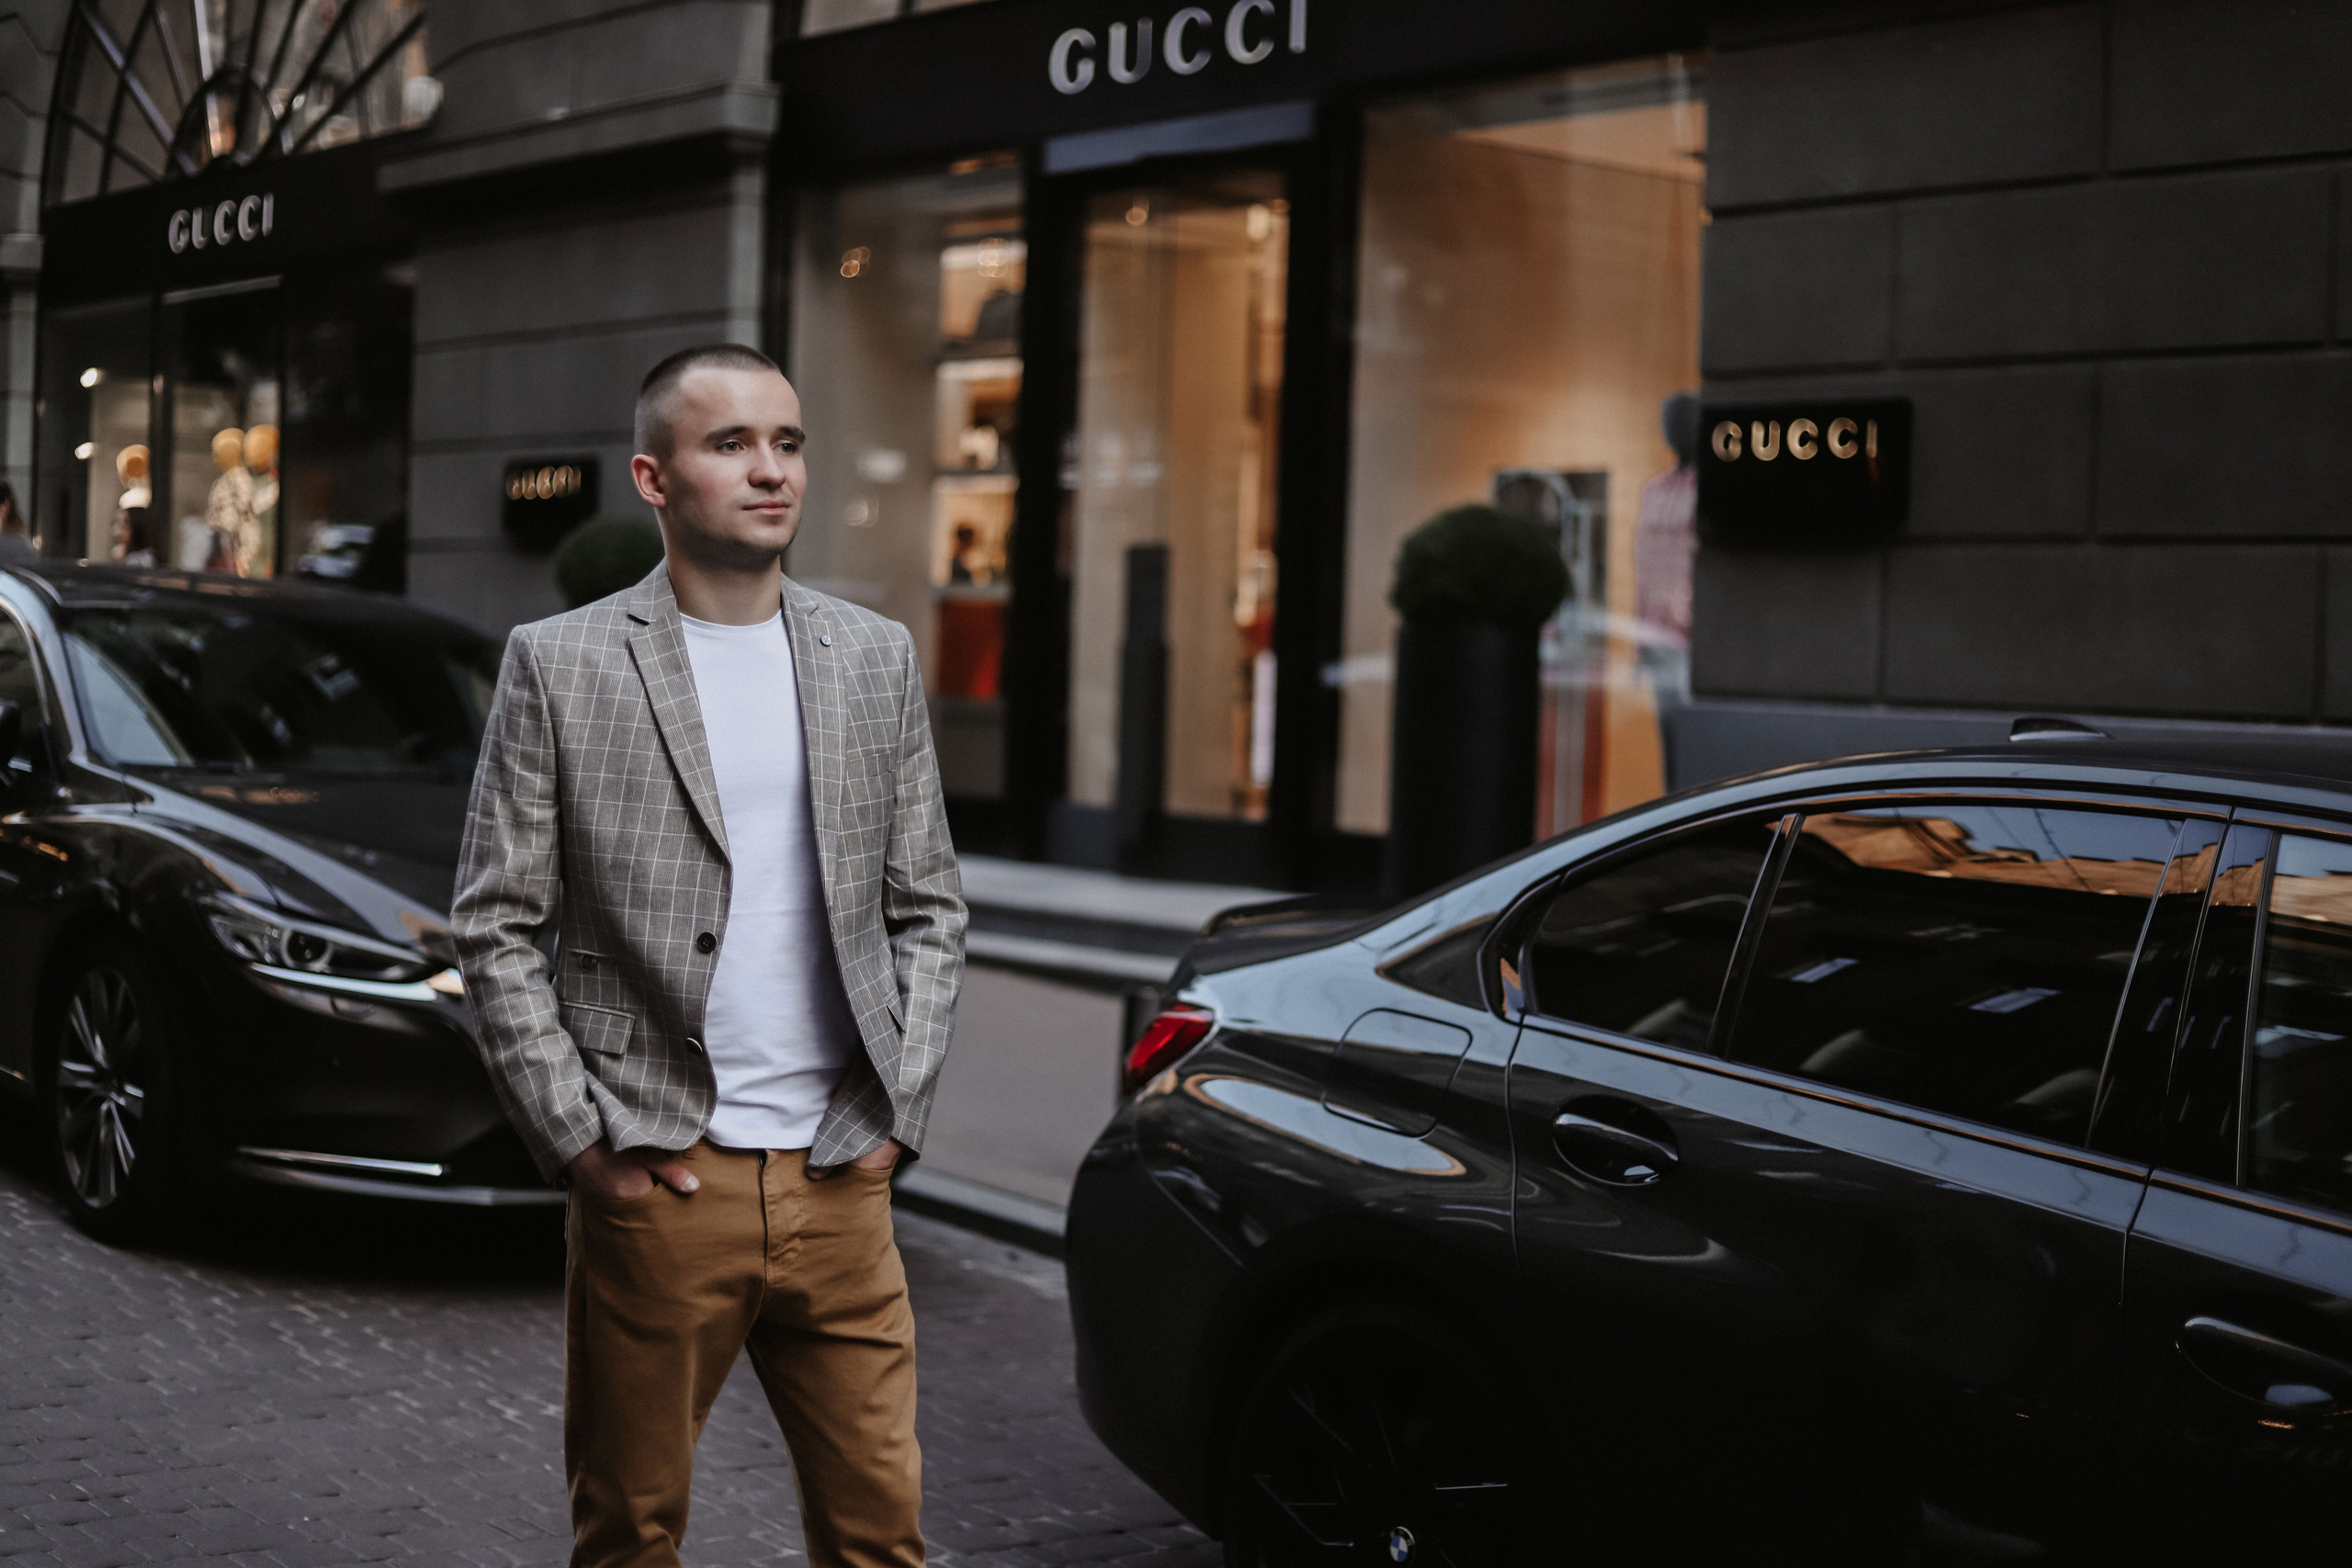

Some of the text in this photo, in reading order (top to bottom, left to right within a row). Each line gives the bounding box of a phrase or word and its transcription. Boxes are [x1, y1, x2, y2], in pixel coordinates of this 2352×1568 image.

[1048, 0, 1306, 95] GUCCI
[168, 192, 275, 254] GUCCI
[1712, 417, 1878, 462] GUCCI
